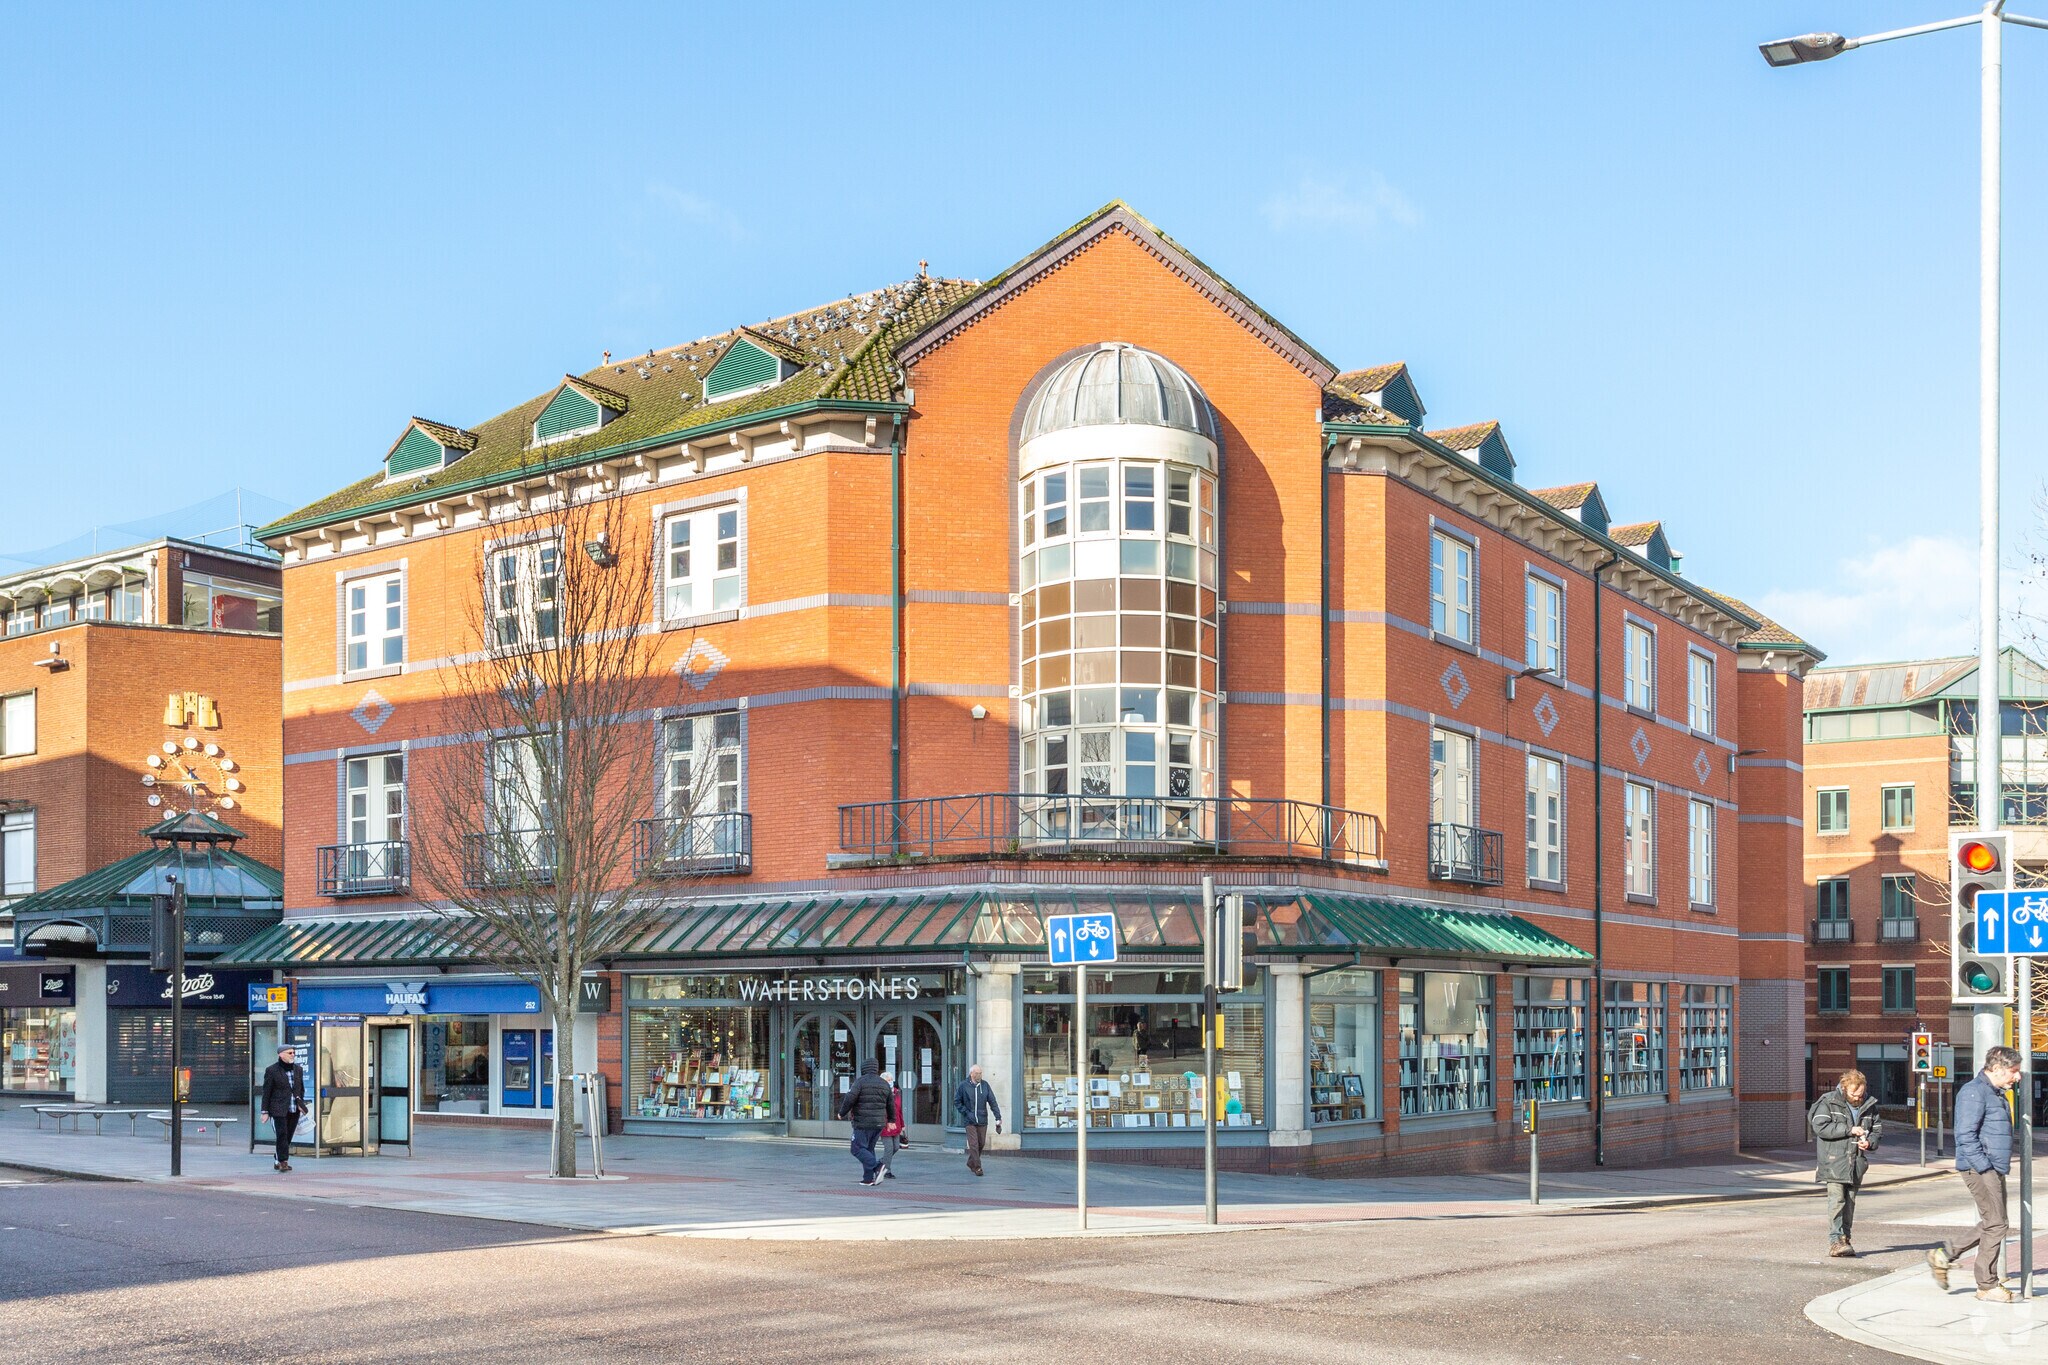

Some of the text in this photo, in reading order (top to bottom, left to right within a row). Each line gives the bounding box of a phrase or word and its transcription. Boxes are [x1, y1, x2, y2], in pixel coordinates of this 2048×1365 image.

[1176, 779, 1186, 788] W
[583, 982, 603, 1000] W
[738, 977, 918, 1001] WATERSTONES
[385, 993, 426, 1004] HALIFAX
[1443, 982, 1460, 1011] W
[525, 1001, 536, 1009] 252
